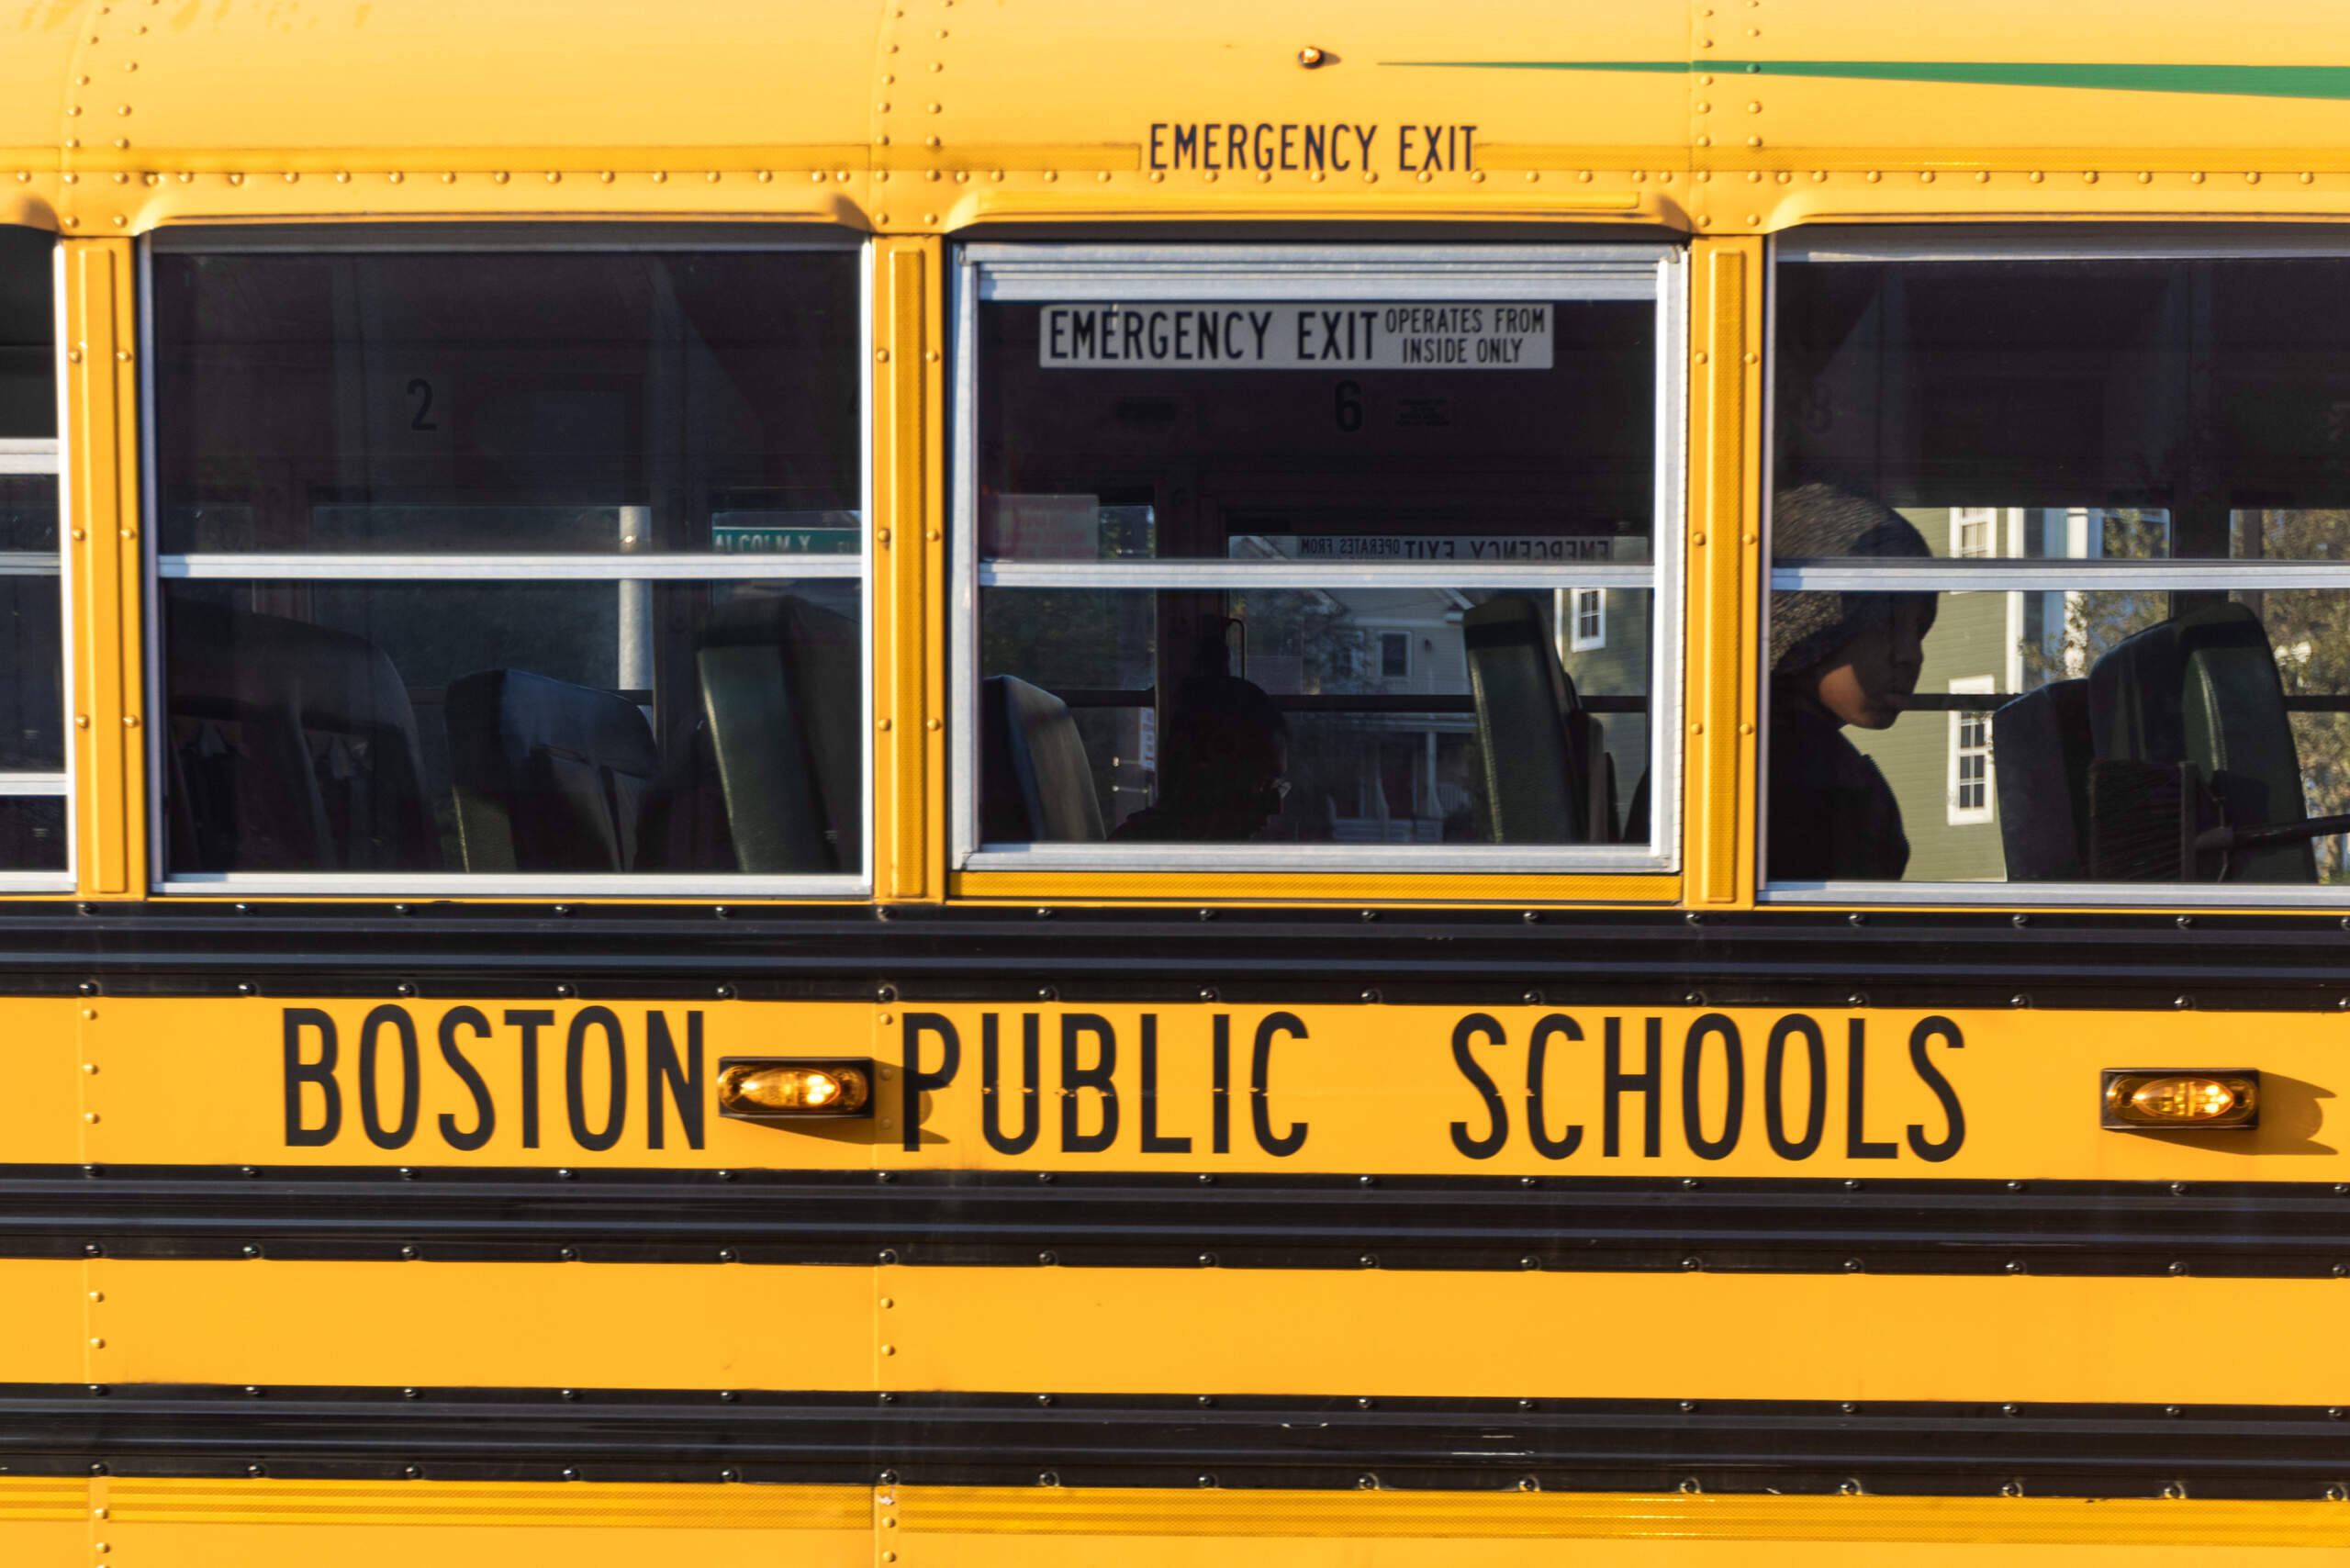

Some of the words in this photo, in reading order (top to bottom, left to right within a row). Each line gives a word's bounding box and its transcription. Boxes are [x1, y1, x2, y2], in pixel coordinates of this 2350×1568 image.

[1151, 124, 1376, 171] EMERGENCY
[1400, 126, 1478, 171] EXIT
[1050, 309, 1273, 361] EMERGENCY
[1297, 310, 1379, 361] EXIT
[1385, 308, 1483, 335] OPERATES
[1494, 308, 1546, 334] FROM
[1402, 337, 1469, 364] INSIDE
[1476, 337, 1524, 364] ONLY
[408, 378, 437, 431] 2
[1335, 379, 1364, 432] 6
[714, 534, 791, 553] ALCOLM
[283, 1004, 704, 1151] BOSTON
[902, 1012, 1309, 1157] PUBLIC
[1450, 1013, 1965, 1162] SCHOOLS
